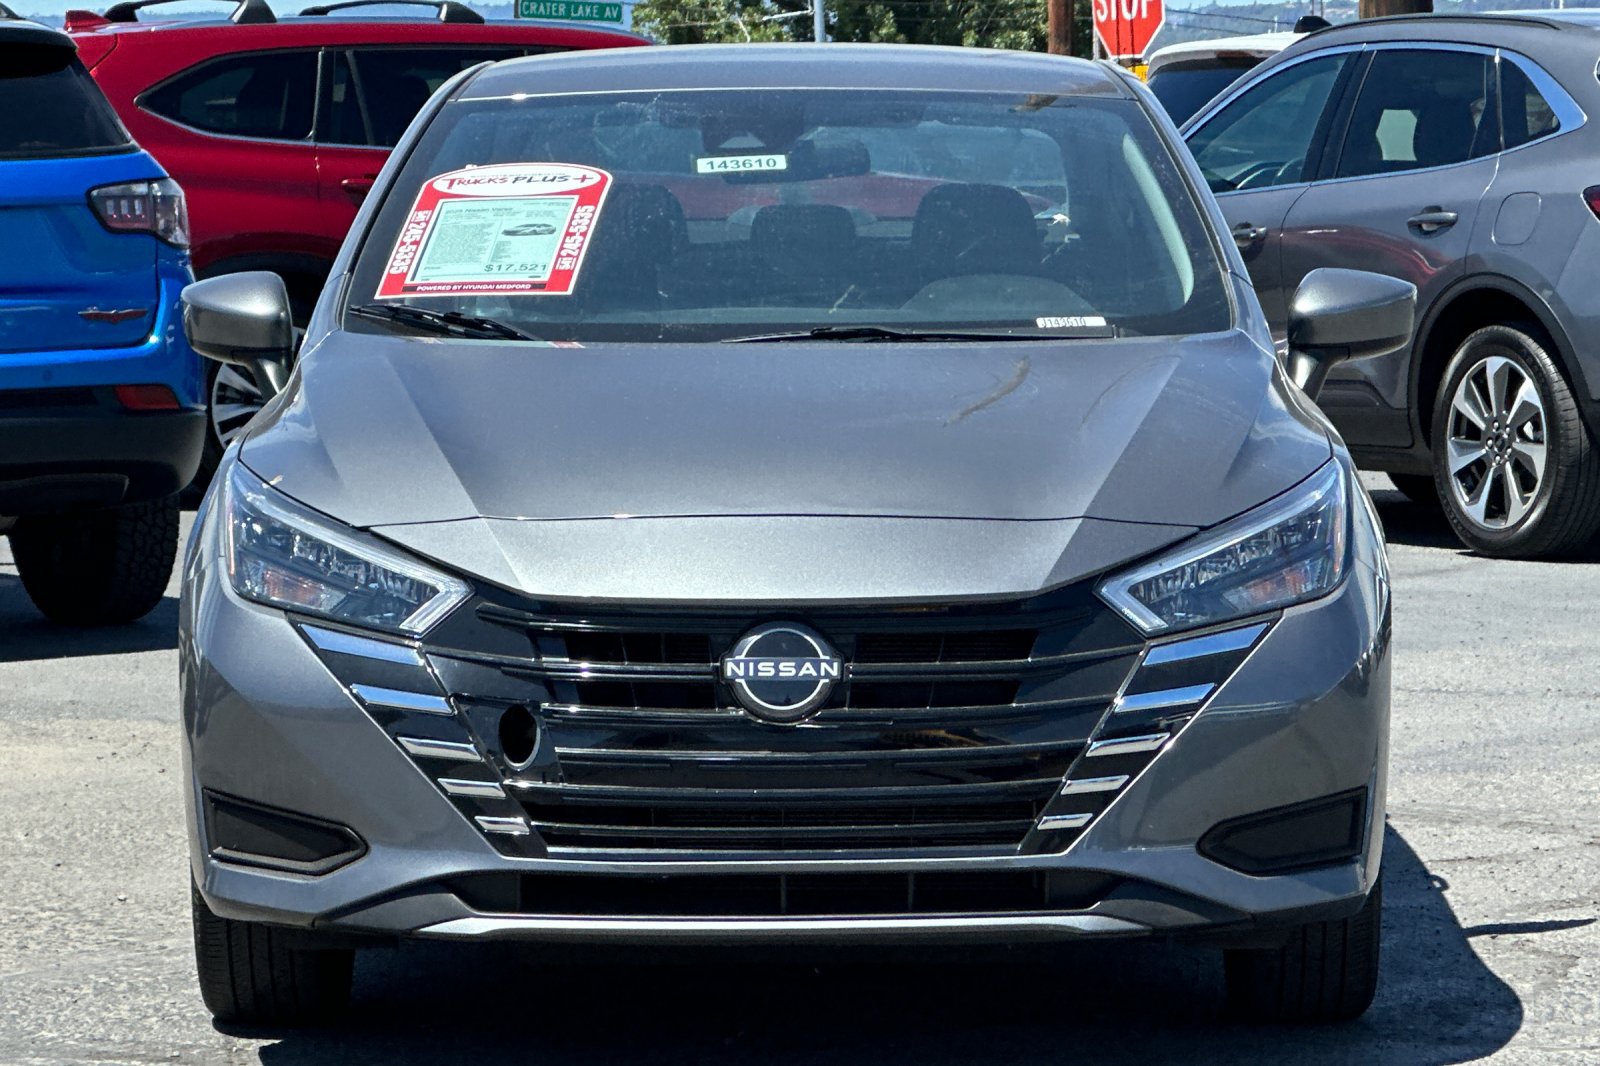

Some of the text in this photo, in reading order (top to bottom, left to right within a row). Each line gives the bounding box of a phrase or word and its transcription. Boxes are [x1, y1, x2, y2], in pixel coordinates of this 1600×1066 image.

[522, 1, 619, 18] CRATER LAKE AV
[706, 158, 777, 170] 143610
[560, 205, 596, 257] 245-5335
[483, 263, 548, 272] $17,521
[726, 661, 839, 677] NISSAN
